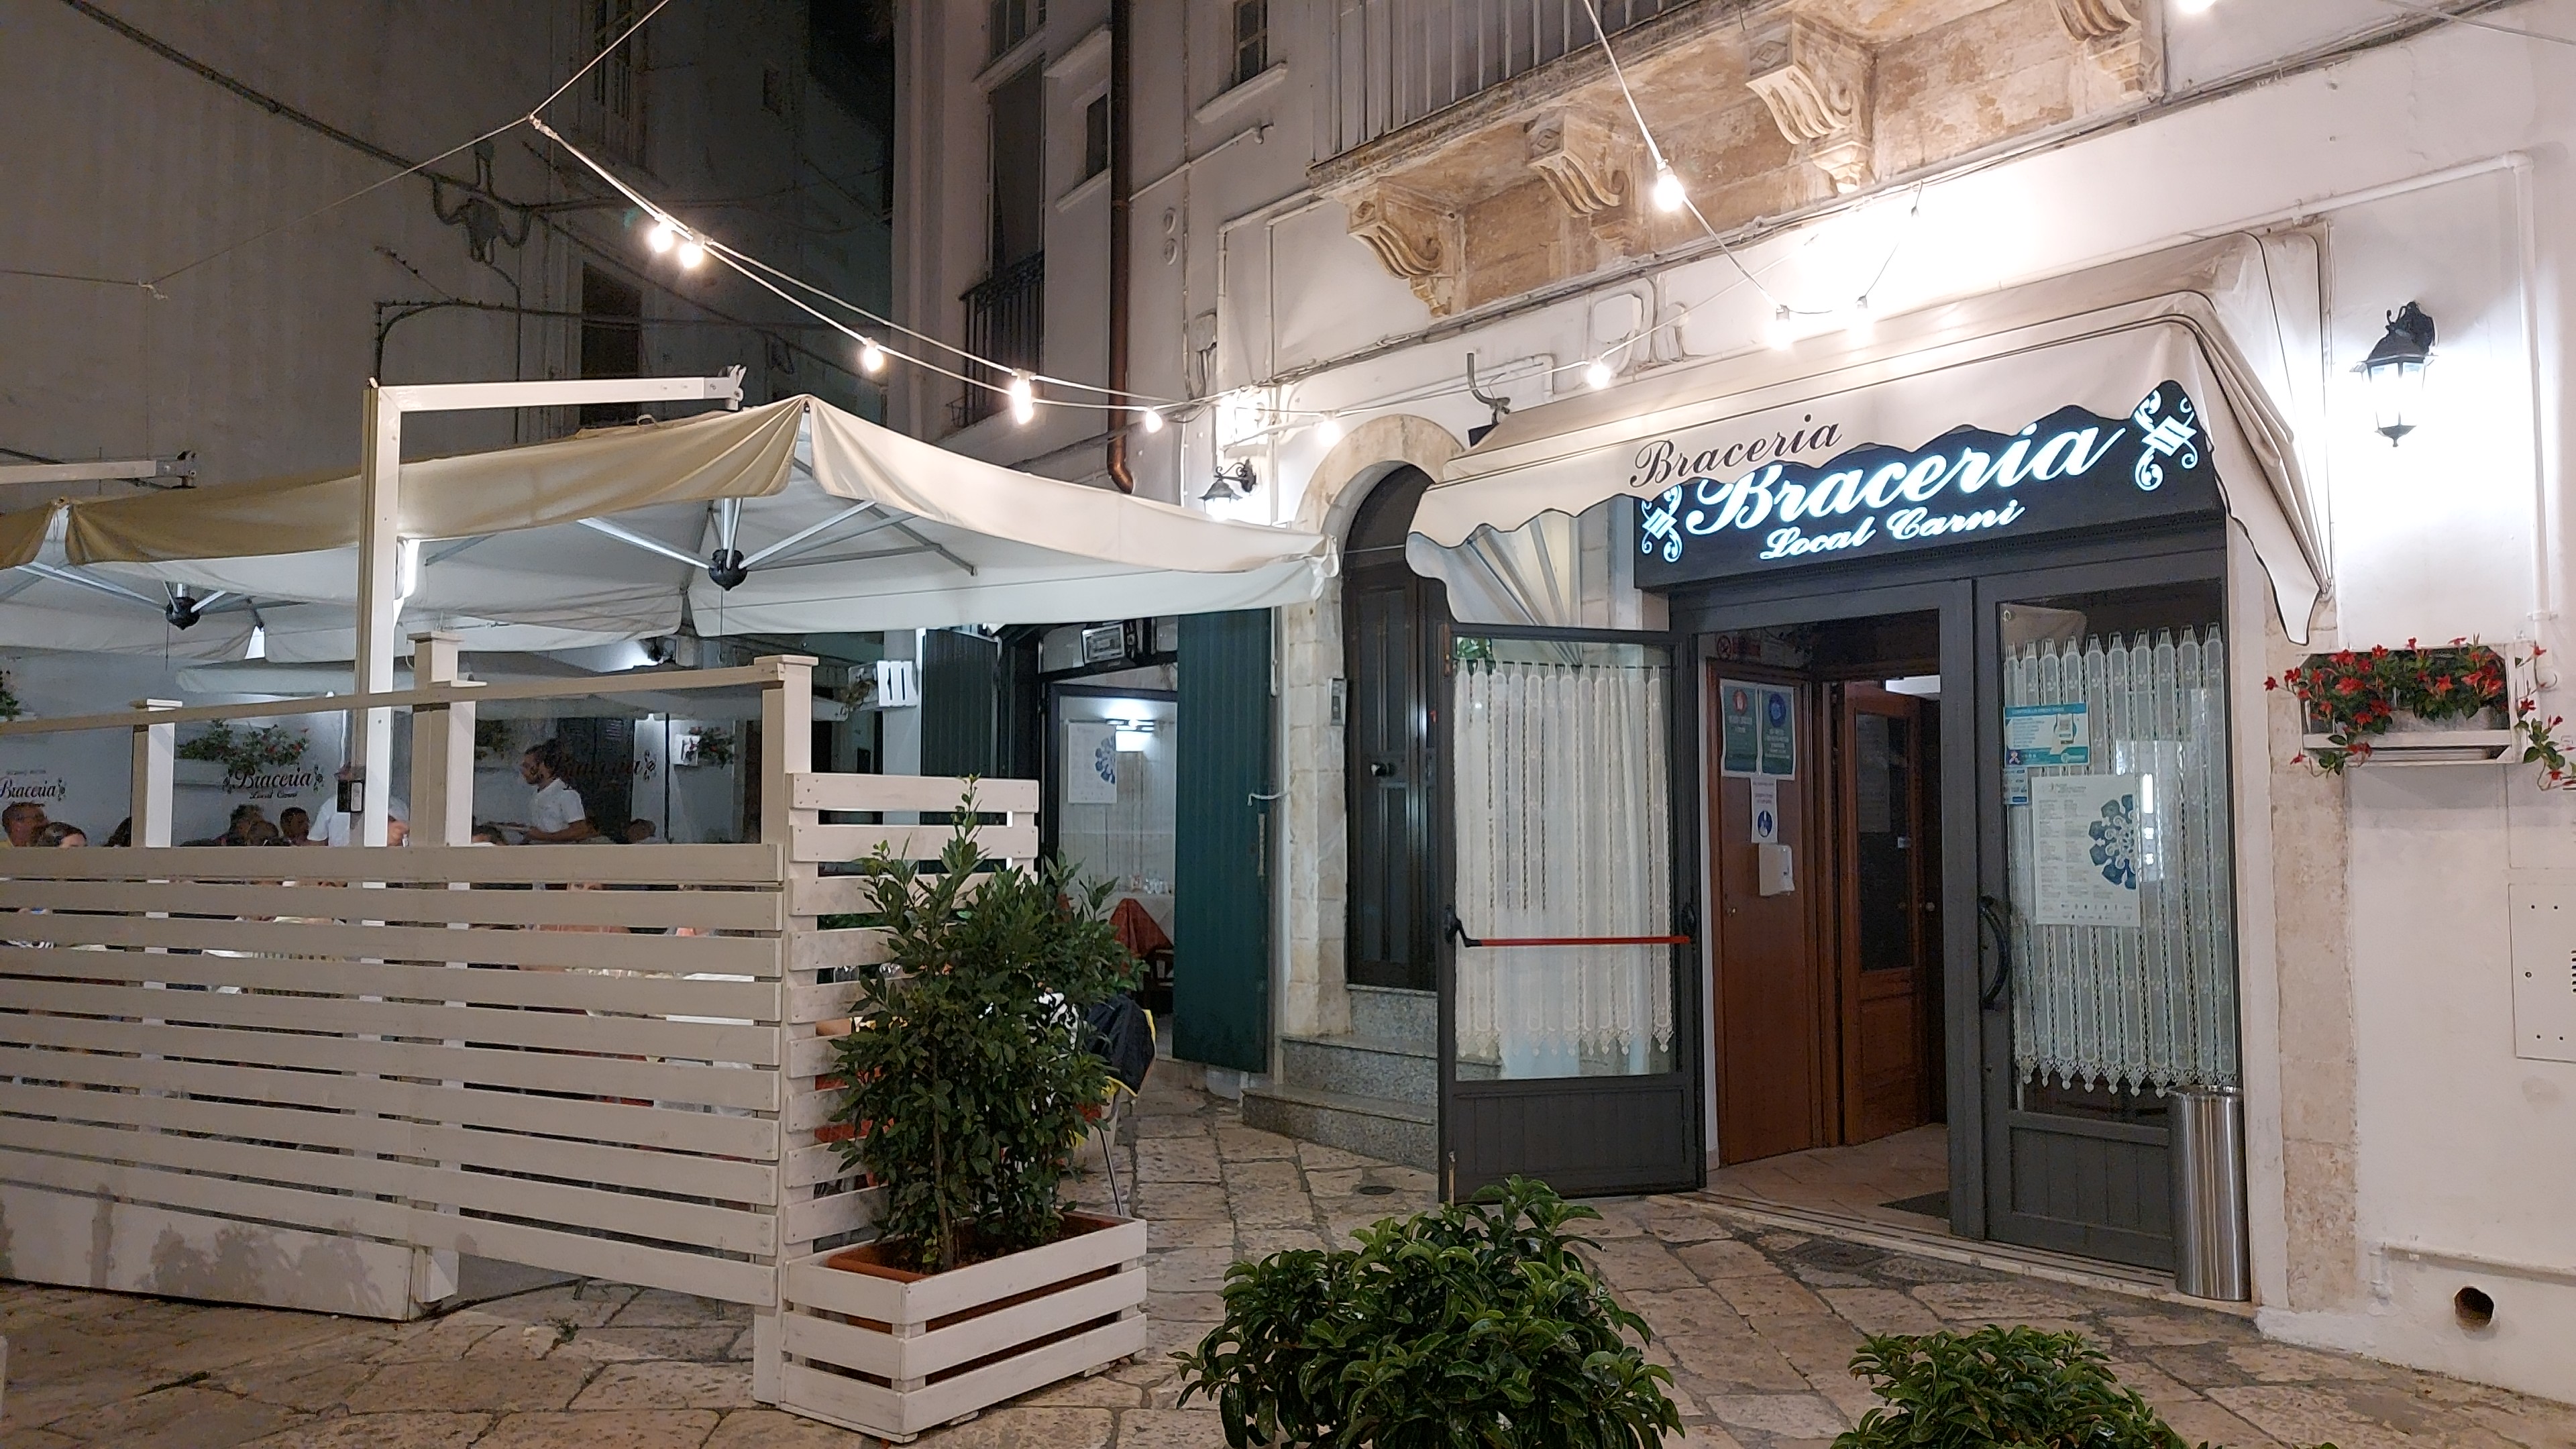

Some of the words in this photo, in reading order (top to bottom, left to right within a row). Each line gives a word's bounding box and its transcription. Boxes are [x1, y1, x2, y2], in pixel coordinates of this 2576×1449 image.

[1629, 414, 1843, 488] Braceria
[1686, 423, 2126, 535] Braceria
[1760, 517, 1876, 559] Local
[1886, 499, 2025, 541] Carni
